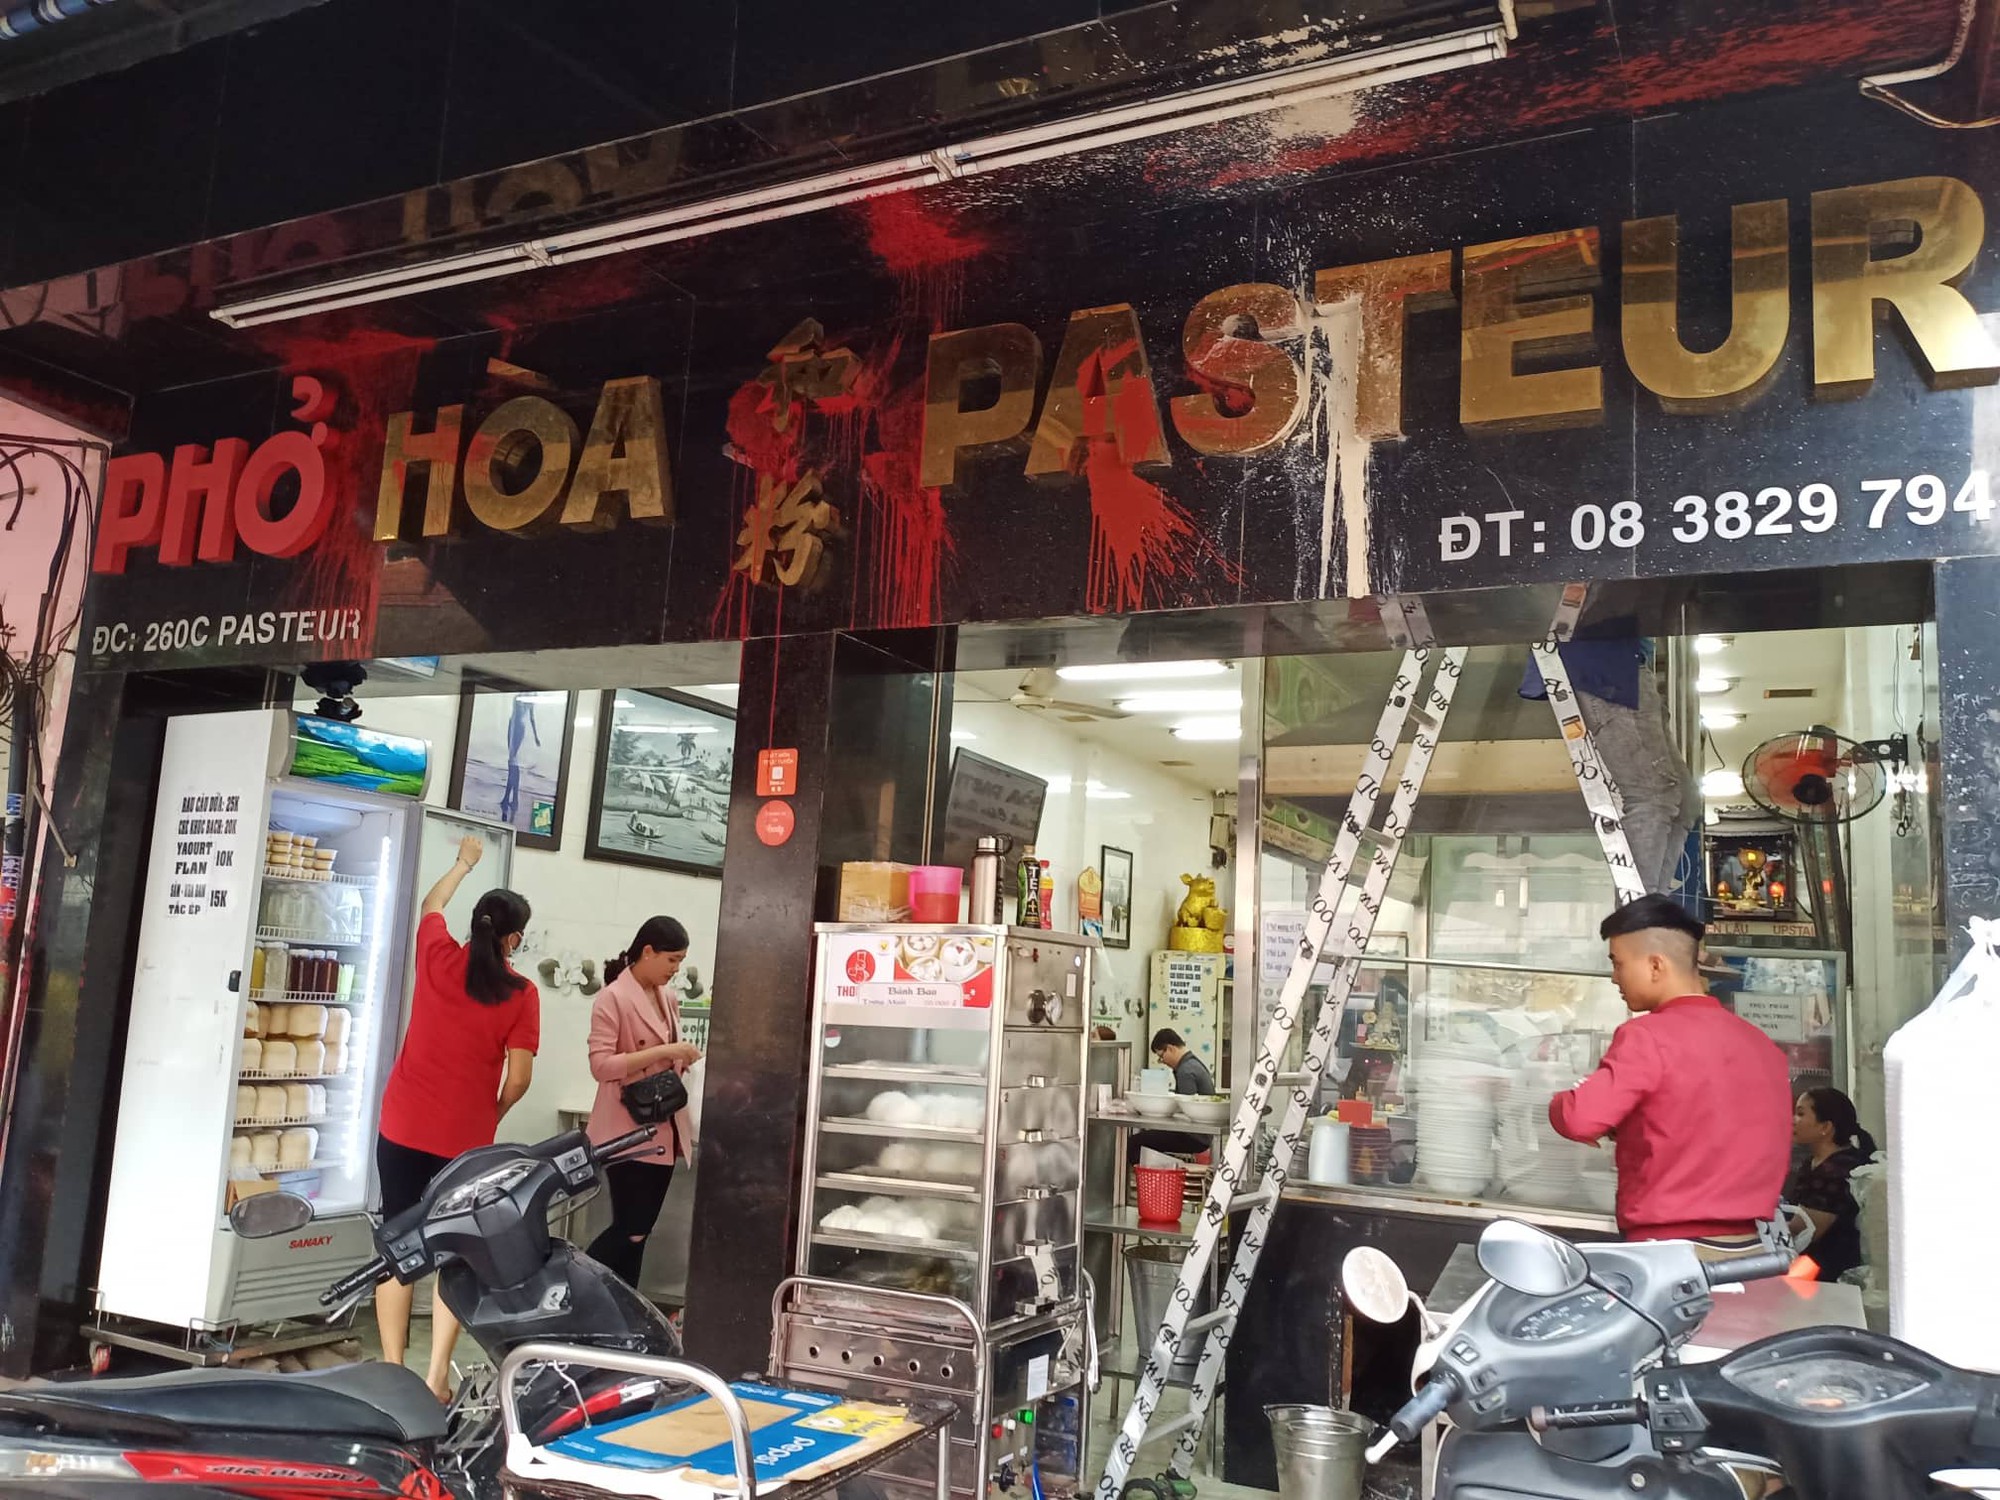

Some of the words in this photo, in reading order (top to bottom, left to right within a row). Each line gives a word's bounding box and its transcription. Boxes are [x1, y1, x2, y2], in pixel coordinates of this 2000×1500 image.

[92, 376, 337, 573] PHỞ
[373, 357, 672, 542] HÒA
[920, 175, 2000, 488] PASTEUR
[1438, 511, 1545, 561] ĐT:
[1570, 501, 1645, 551] 08
[1672, 483, 1838, 544] 3829
[1860, 470, 1998, 529] 794
[92, 622, 136, 656] ĐC:
[143, 616, 210, 652] 260C
[217, 609, 362, 646] PASTEUR
[177, 841, 213, 856] YAOURT
[175, 861, 208, 875] FLAN
[209, 889, 228, 907] 15K
[1773, 925, 1816, 937] UPSTAI
[837, 985, 858, 997] THO
[289, 1235, 333, 1249] SANAKY
